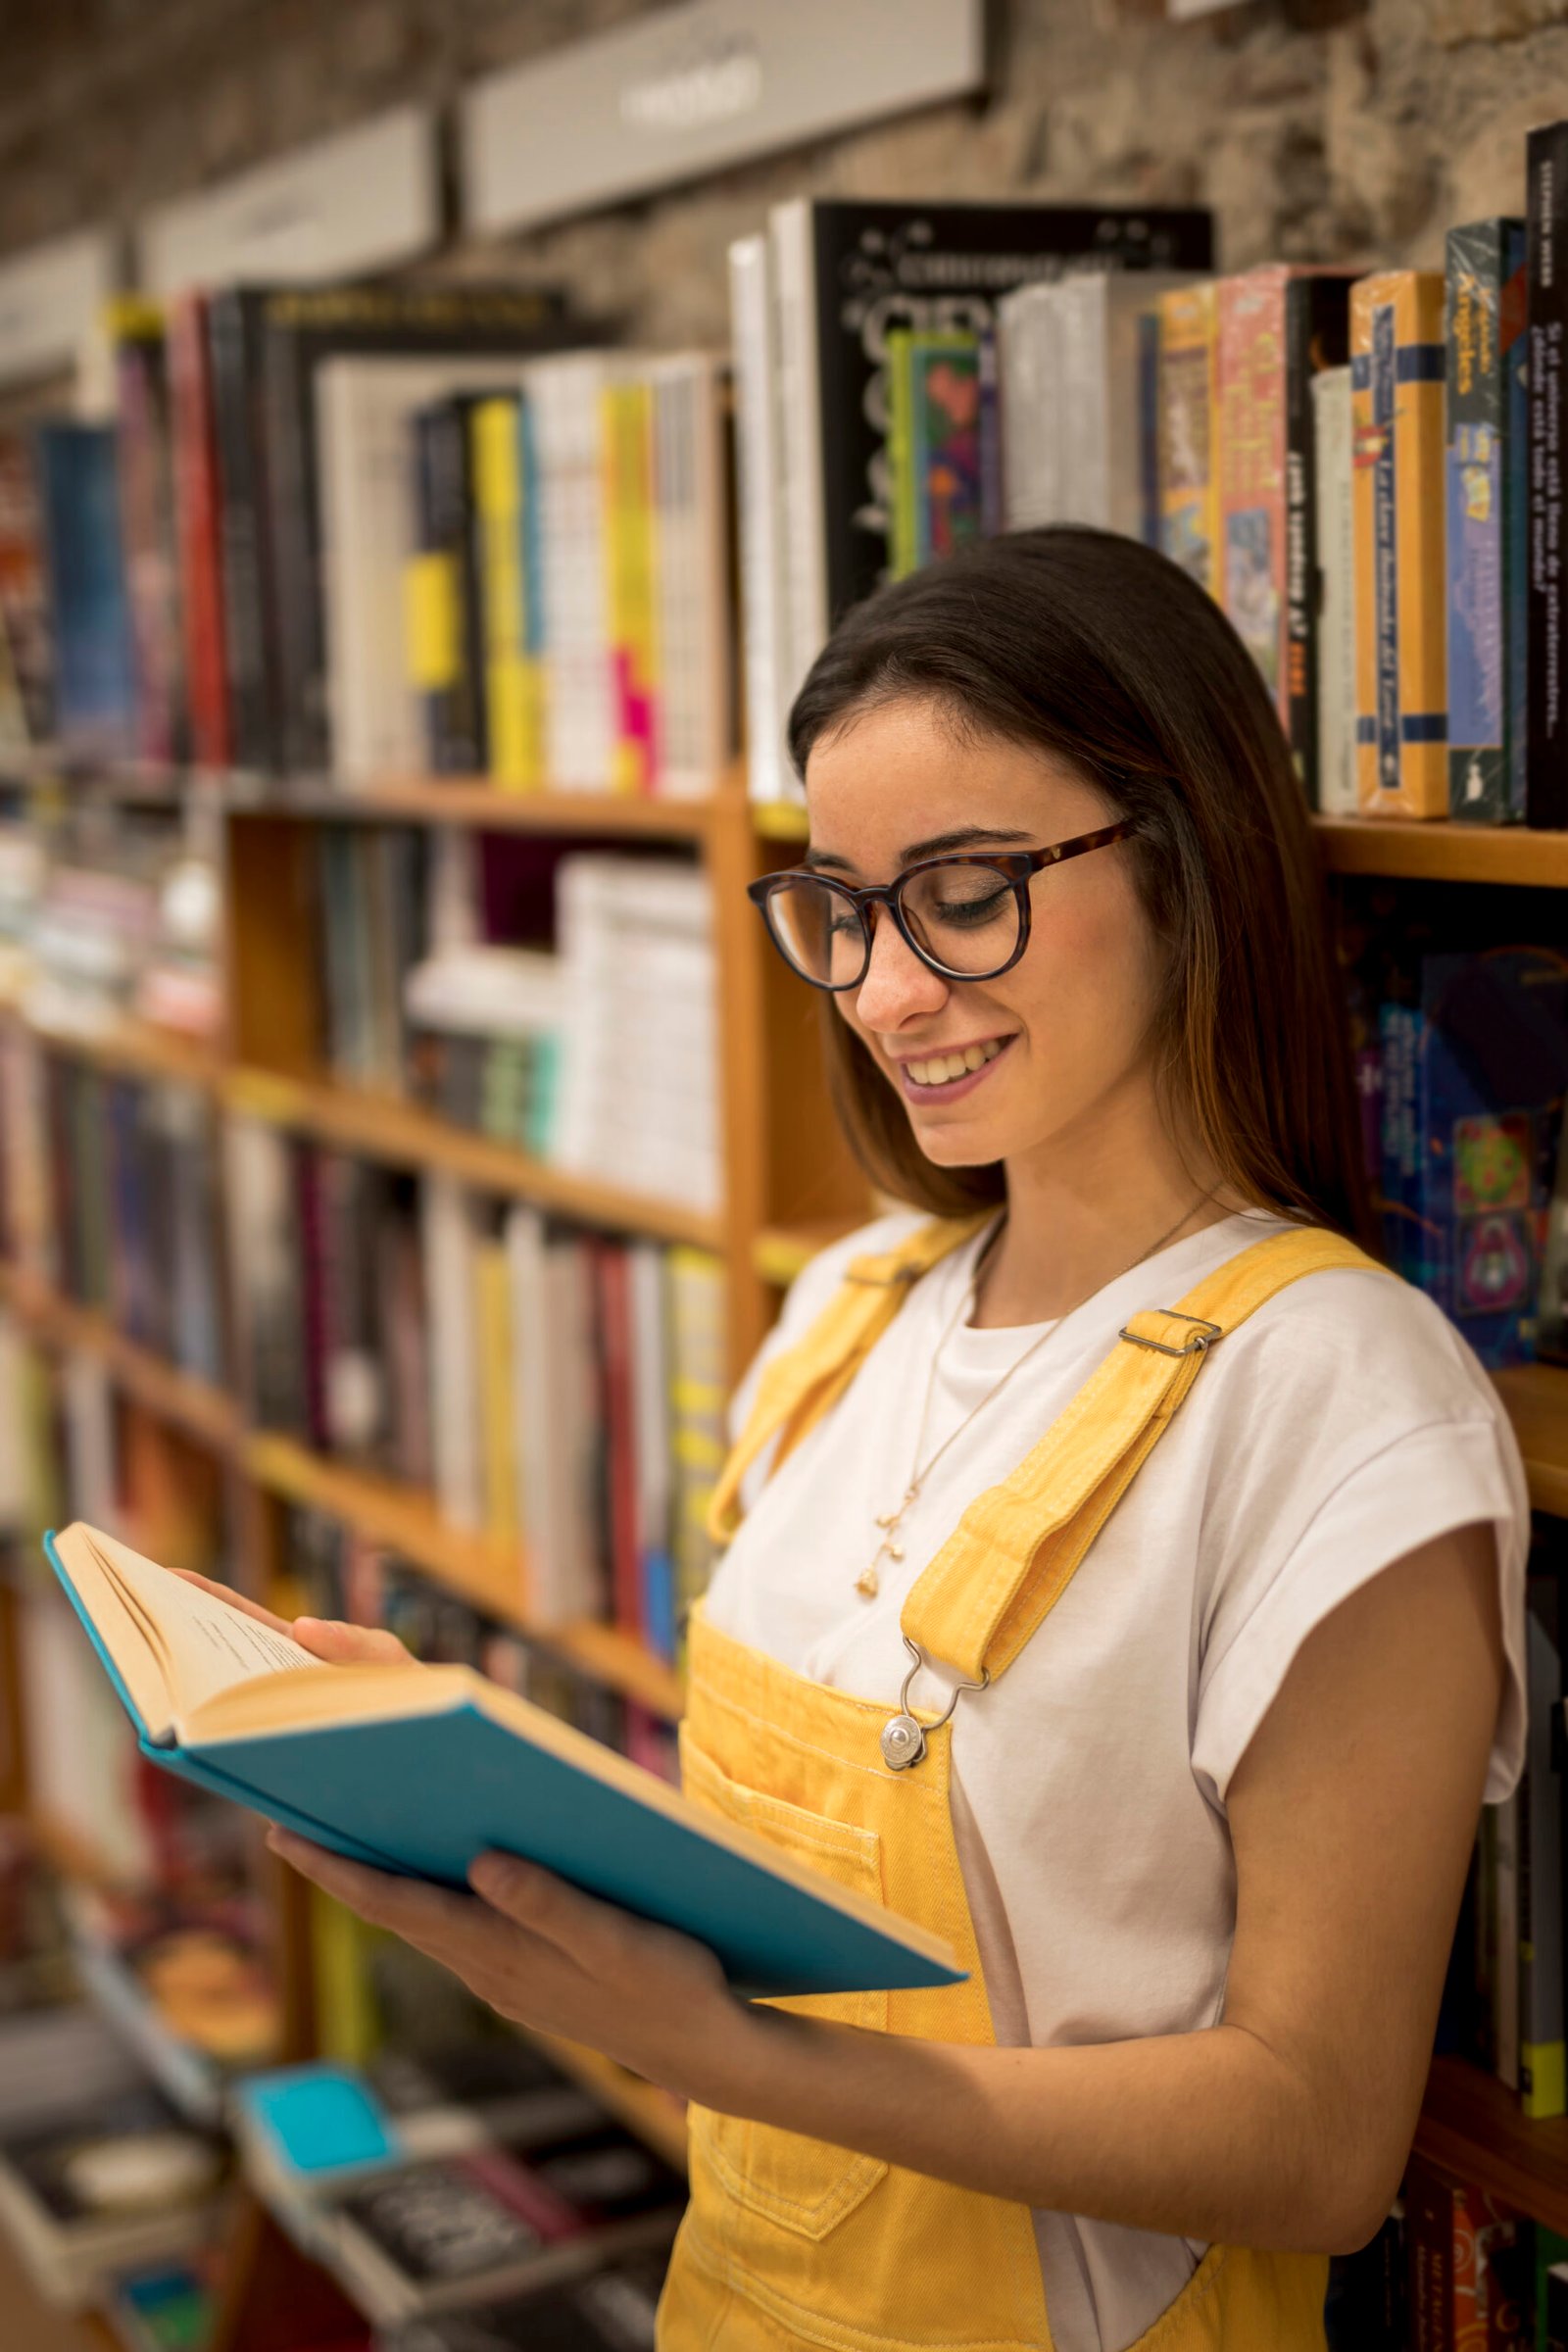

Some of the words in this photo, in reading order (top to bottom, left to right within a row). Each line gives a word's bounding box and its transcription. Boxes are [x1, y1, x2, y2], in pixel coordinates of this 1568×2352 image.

[1541, 160, 1553, 233] STEPHEN
[1540, 238, 1552, 288] WEBB
[1547, 321, 1563, 341] Si
[1547, 347, 1561, 366] el
[1533, 399, 1546, 440] está
[1547, 370, 1559, 451] universo
[1533, 444, 1546, 489] todo
[1547, 456, 1561, 497] está
[1533, 494, 1546, 513] el
[1547, 502, 1562, 550] lleno
[1533, 516, 1546, 593] mundo?
[1547, 554, 1561, 577] de
